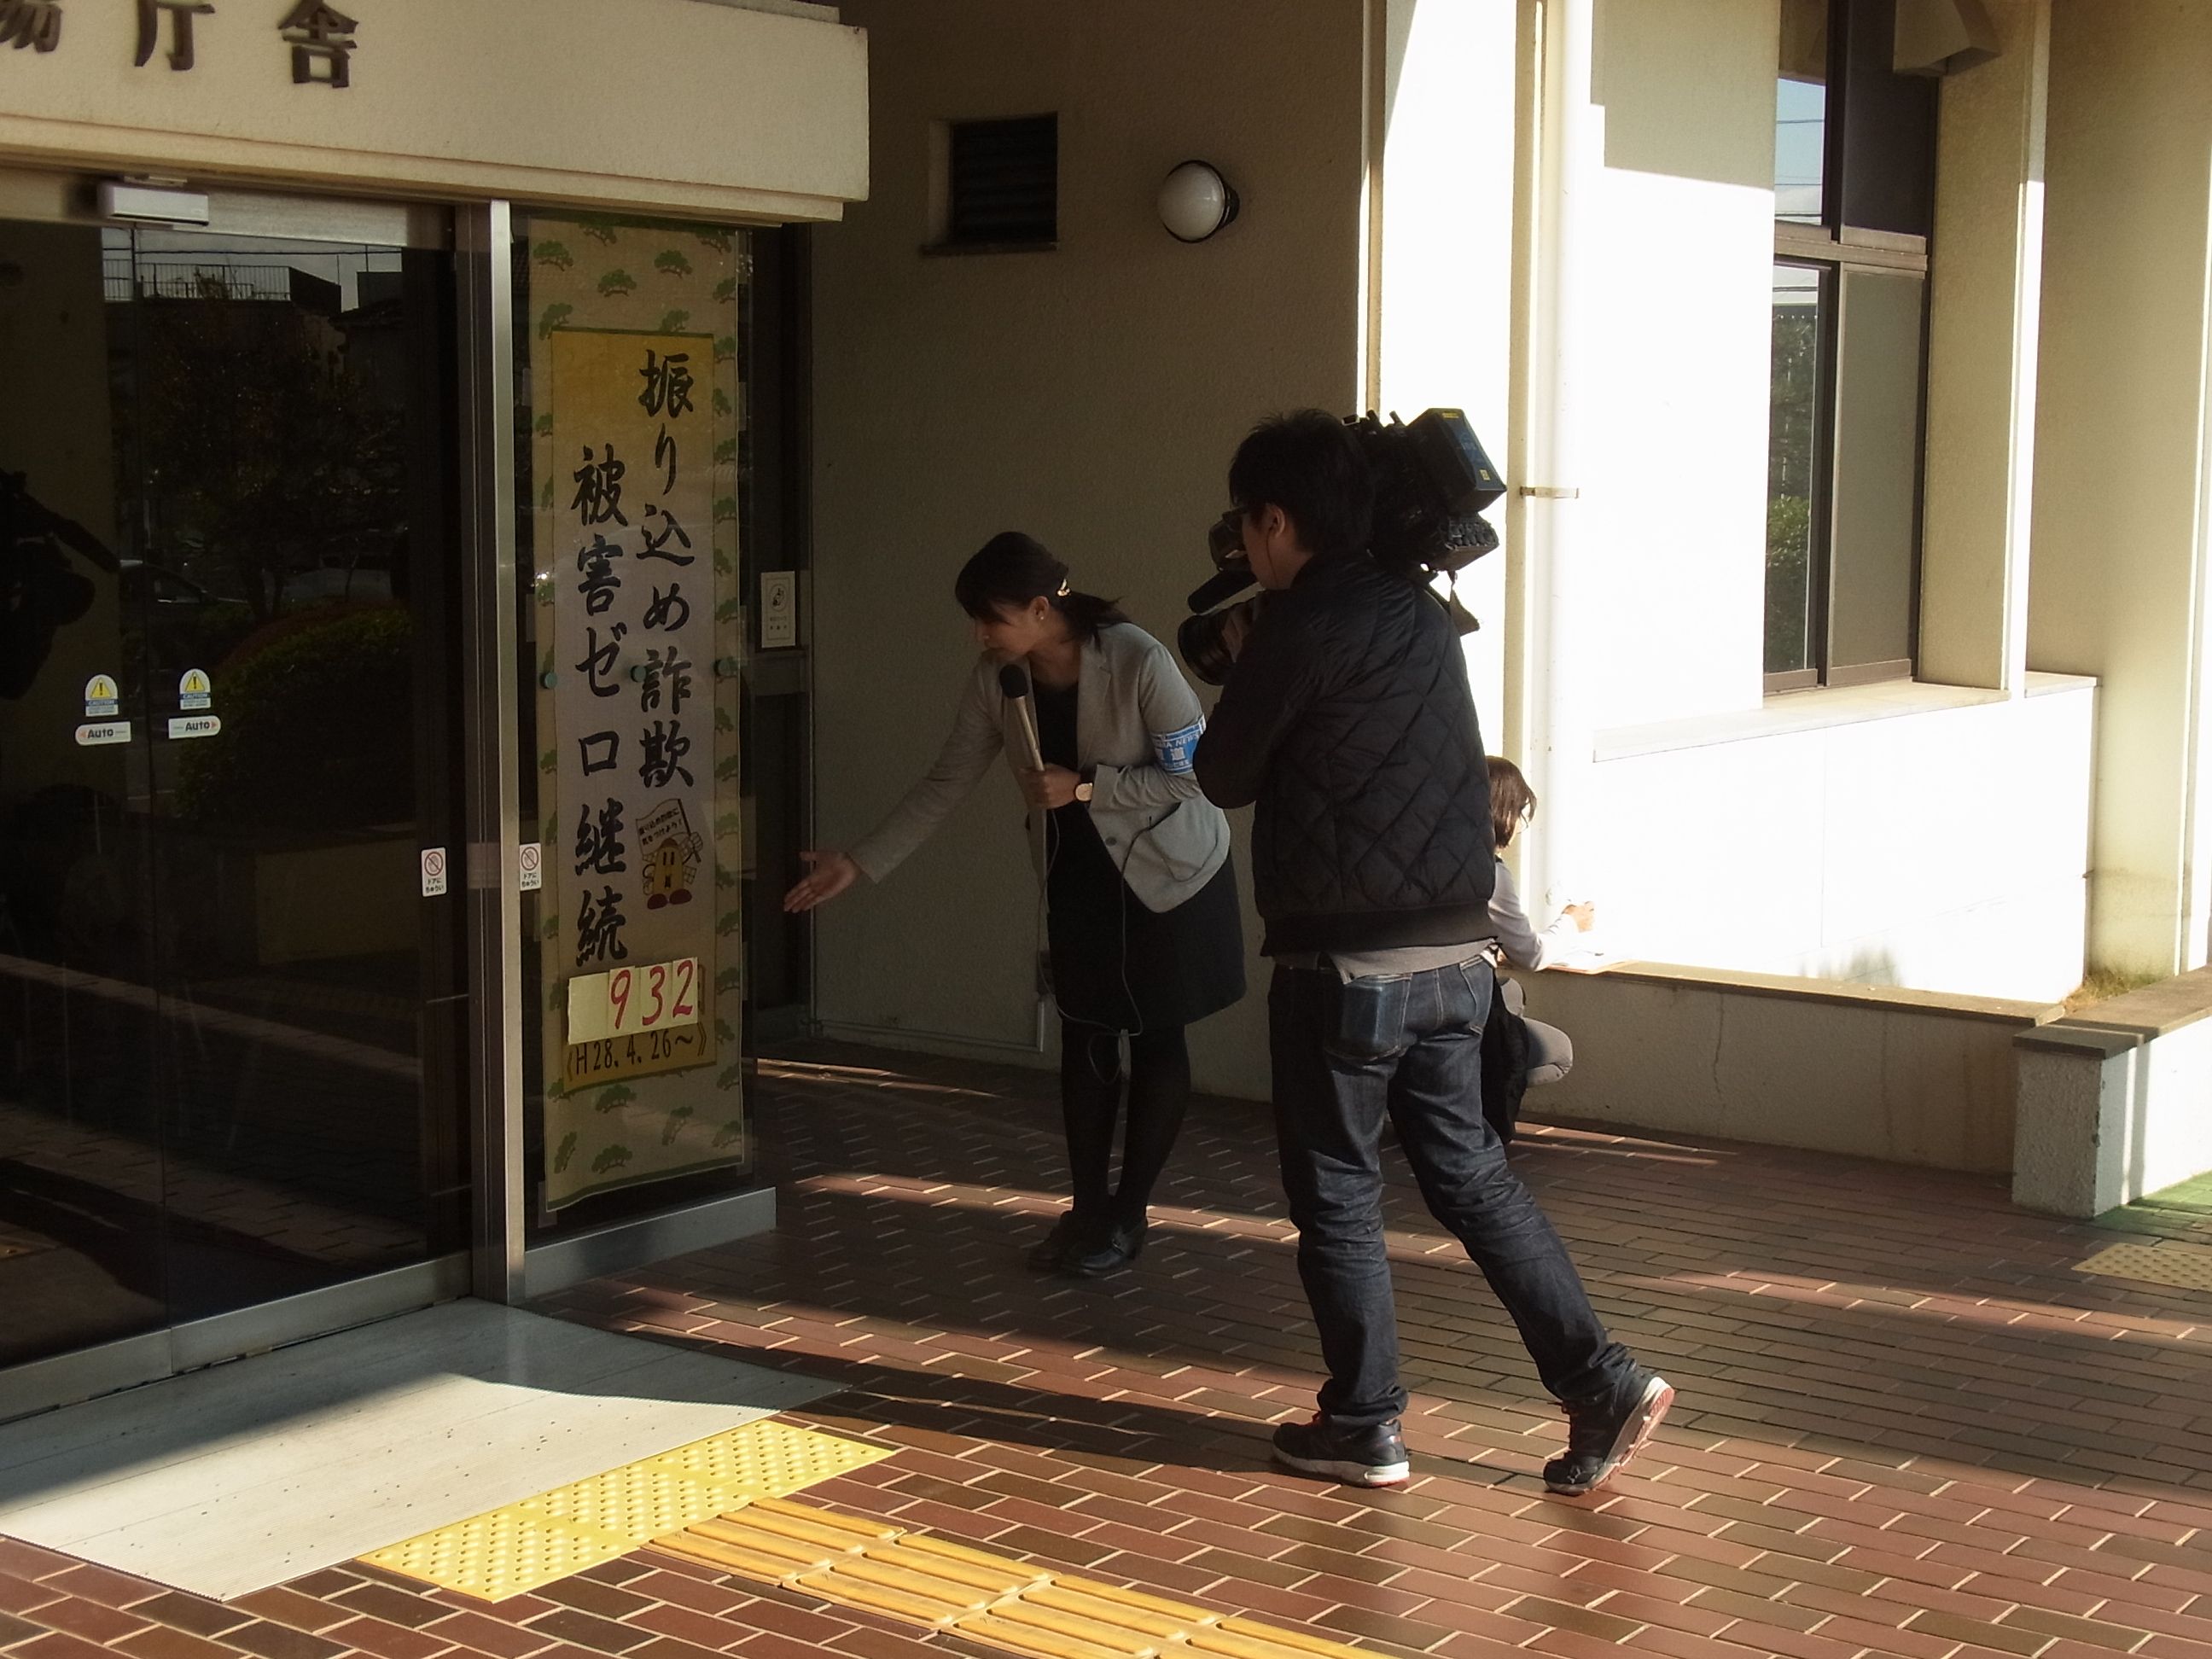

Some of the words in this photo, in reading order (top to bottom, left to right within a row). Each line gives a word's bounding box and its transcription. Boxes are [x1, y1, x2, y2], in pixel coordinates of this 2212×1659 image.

[636, 348, 695, 788] 振り込め詐欺
[87, 728, 114, 739] Auto
[185, 720, 210, 731] Auto
[571, 443, 629, 967] 被害ゼロ継続
[610, 959, 694, 1030] 932
